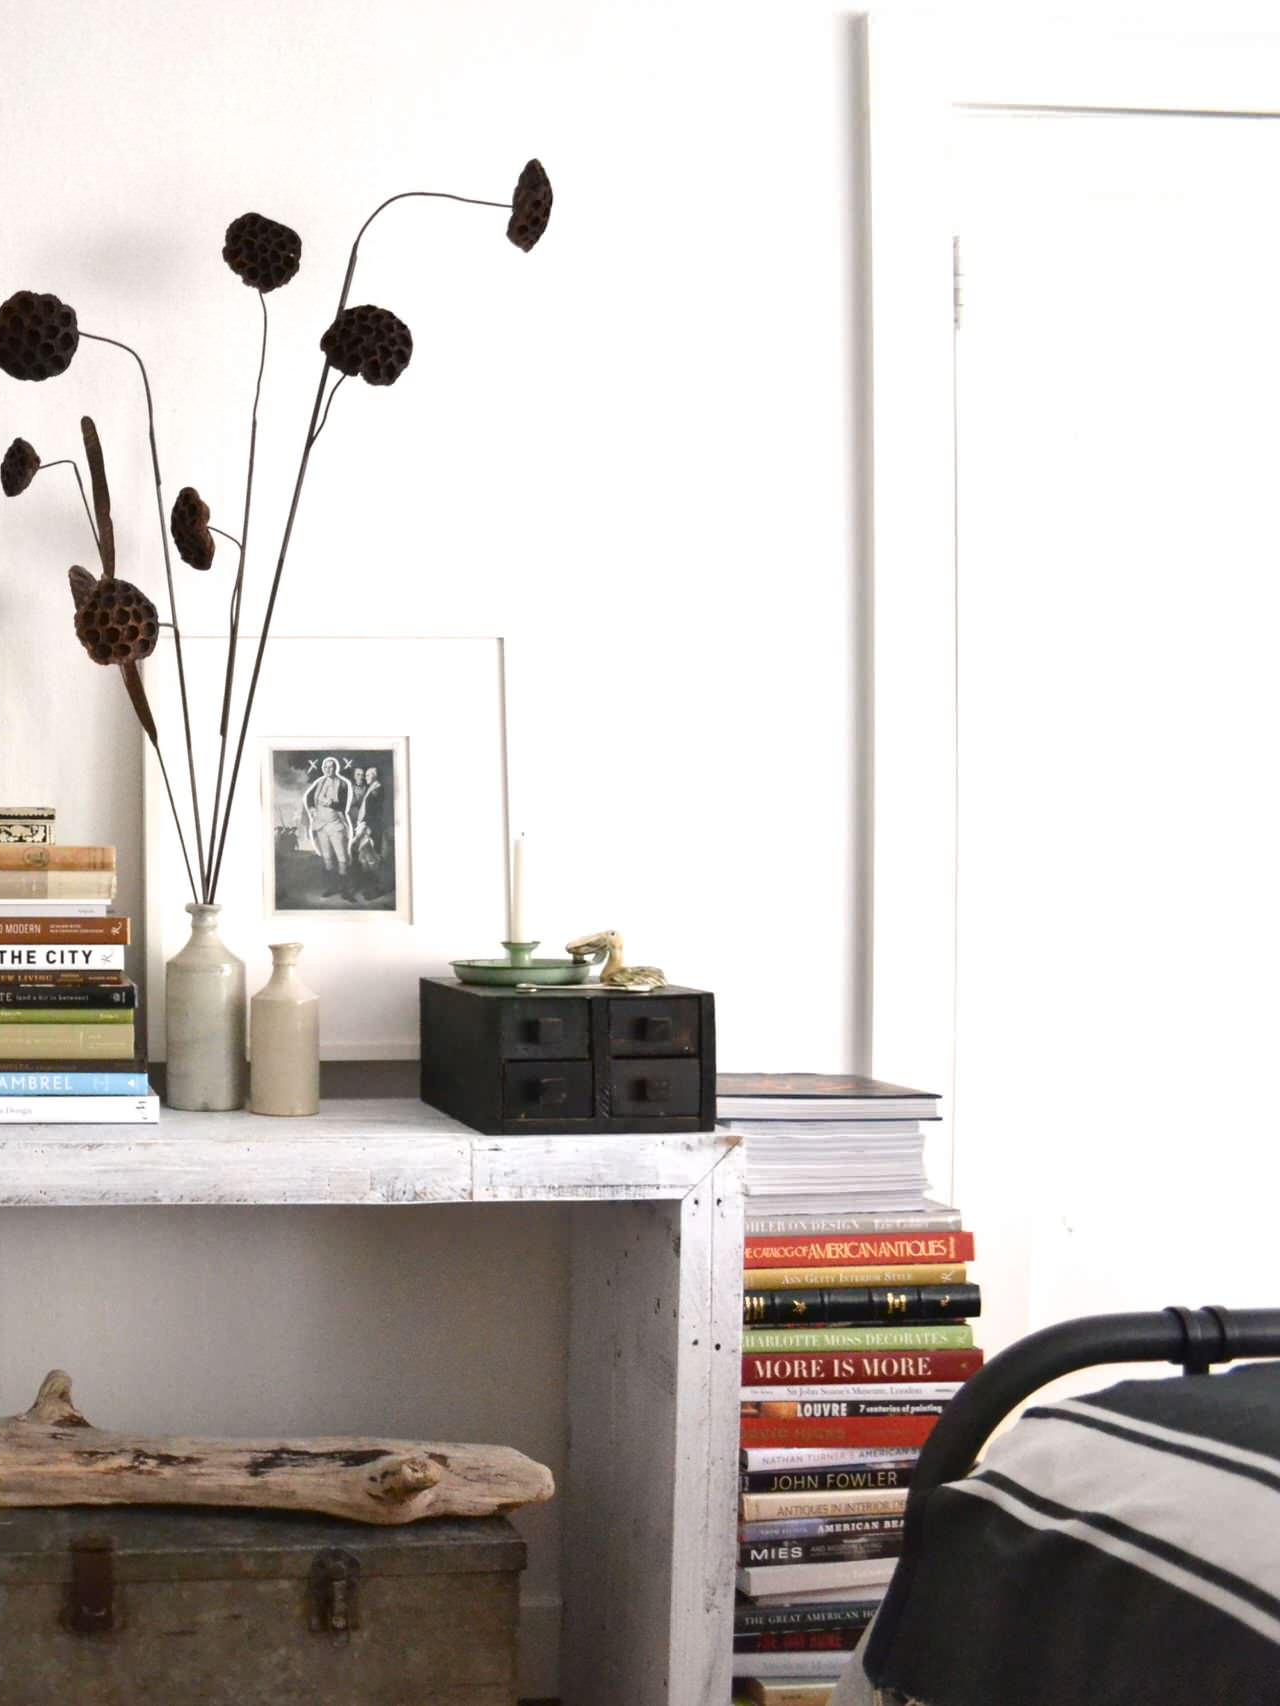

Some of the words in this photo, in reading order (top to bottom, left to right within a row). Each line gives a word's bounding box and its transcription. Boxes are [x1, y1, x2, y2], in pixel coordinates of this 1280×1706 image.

[5, 923, 41, 935] MODERN
[45, 950, 93, 965] CITY
[5, 1106, 33, 1117] Design
[753, 1245, 795, 1259] CATALOG
[794, 1245, 809, 1257] OF
[808, 1241, 878, 1260] AMERICAN
[878, 1239, 947, 1257] ANTIQUES
[823, 1334, 861, 1346] MOSS
[865, 1332, 949, 1345] DECORATES
[754, 1359, 824, 1379] MORE
[833, 1359, 855, 1378] IS
[860, 1357, 932, 1377] MORE
[798, 1387, 818, 1397] John
[890, 1386, 923, 1394] London
[796, 1402, 848, 1417] LOUVRE
[859, 1404, 865, 1413] 7
[866, 1405, 900, 1414] centuries
[901, 1404, 910, 1413] of
[910, 1404, 943, 1414] painting
[762, 1456, 804, 1465] NATHAN
[808, 1452, 856, 1463] TURNER'S
[859, 1449, 912, 1459] AMERICAN
[771, 1475, 819, 1491] JOHN
[826, 1471, 898, 1488] FOWLER
[777, 1503, 830, 1517] ANTIQUES
[831, 1503, 842, 1514] IN
[817, 1521, 880, 1534] AMERICAN
[750, 1547, 803, 1561] MIES
[744, 1617, 766, 1626] THE
[767, 1614, 801, 1624] GREAT
[805, 1610, 859, 1622] AMERICAN
